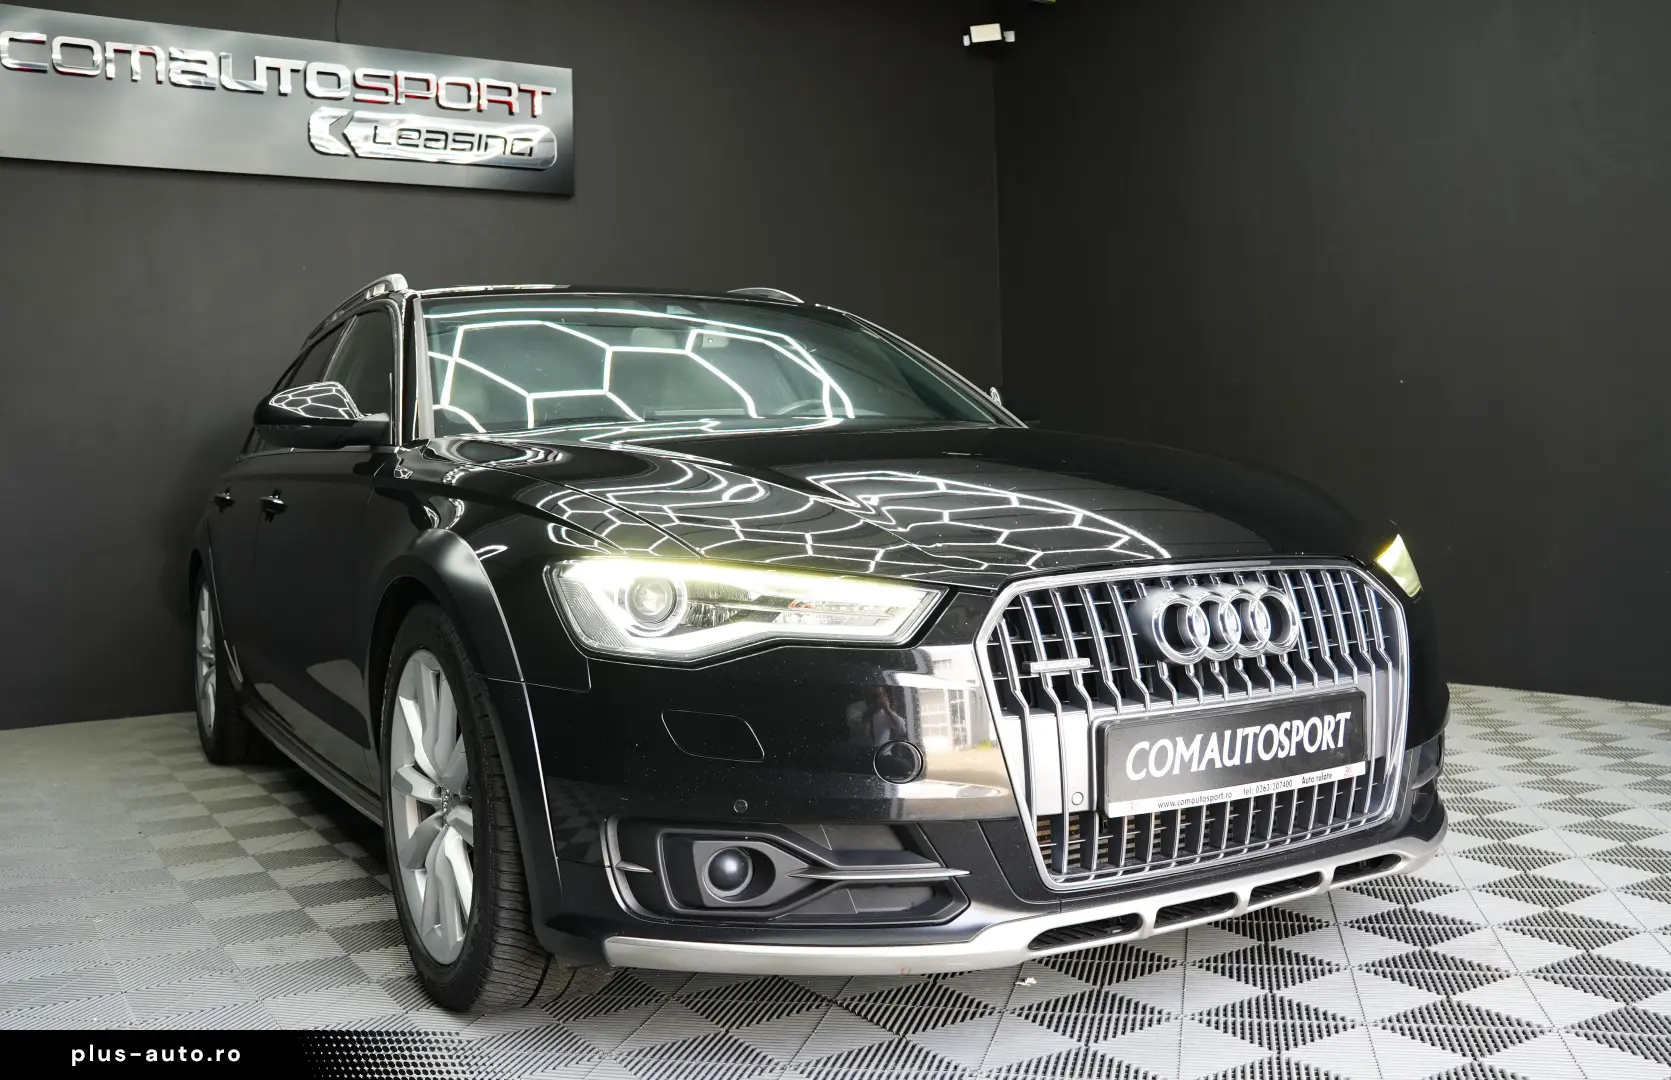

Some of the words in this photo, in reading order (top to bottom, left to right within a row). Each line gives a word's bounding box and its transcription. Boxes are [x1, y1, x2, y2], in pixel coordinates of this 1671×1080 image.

[1126, 711, 1351, 780] COMAUTOSPORT
[1157, 791, 1233, 808] www.comautosport.ro
[1243, 786, 1254, 796] tel:
